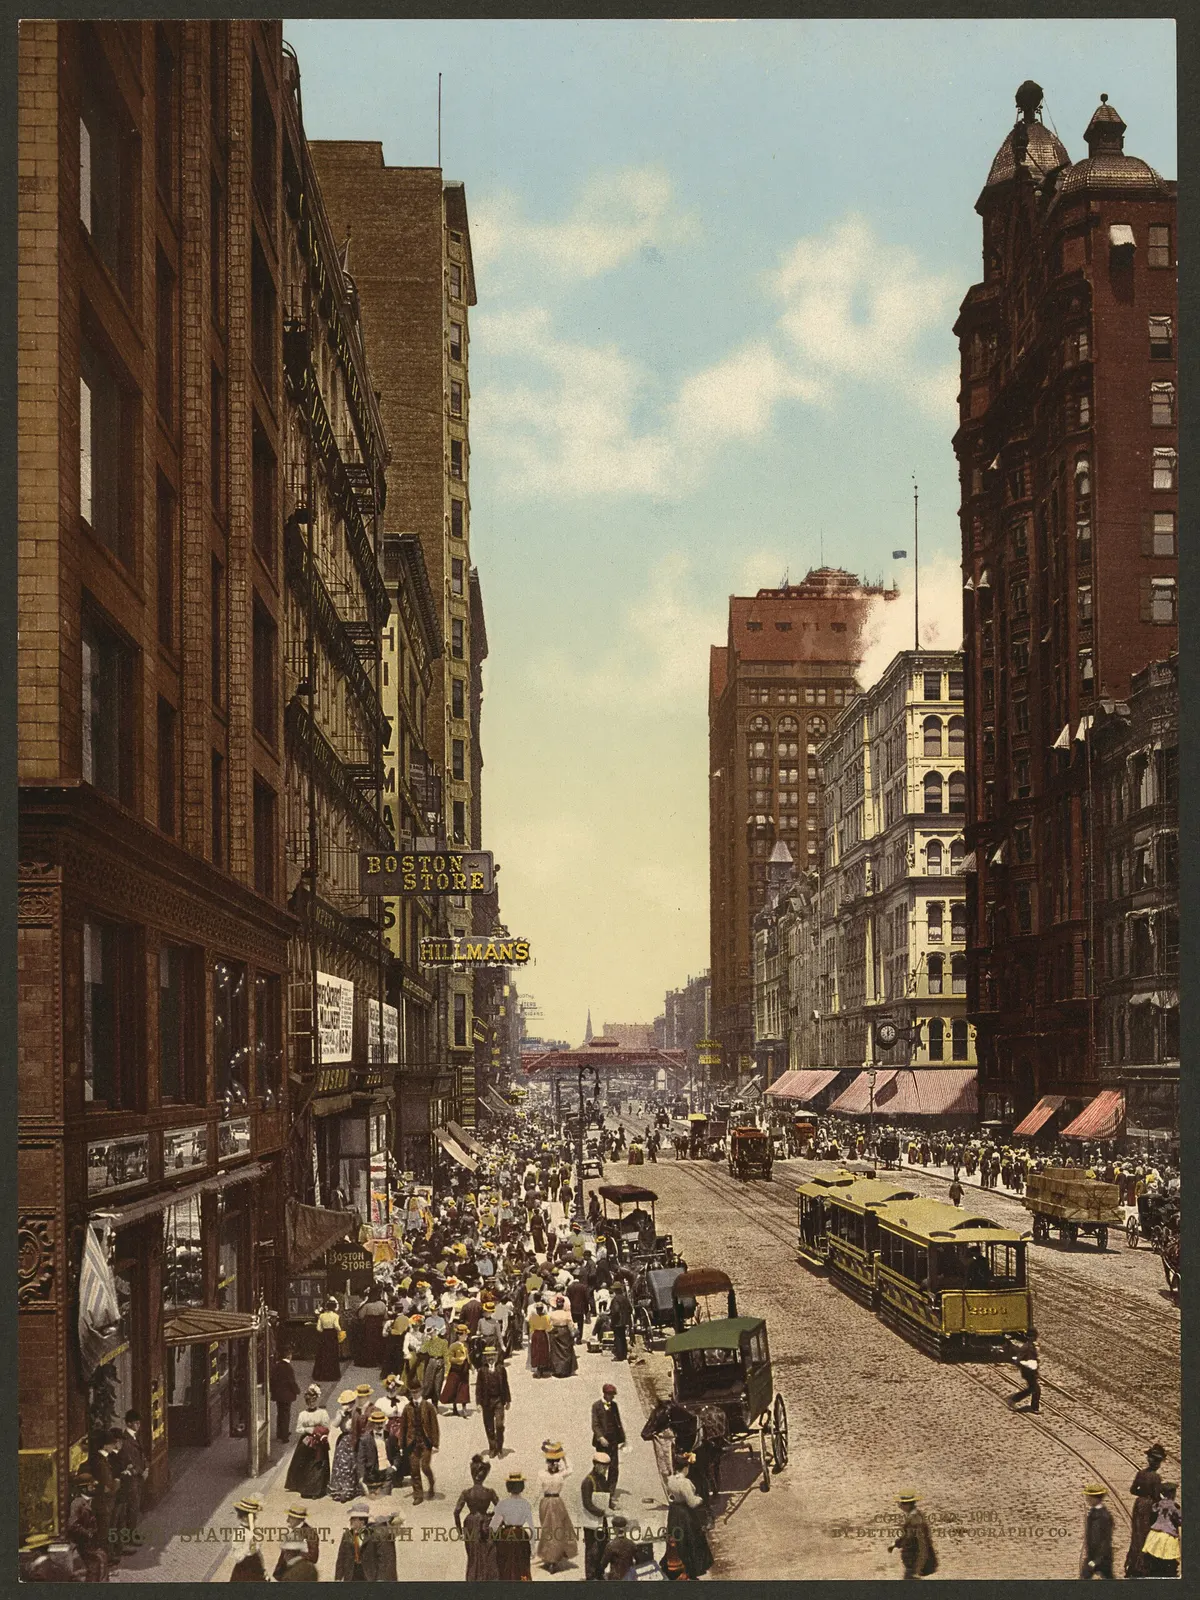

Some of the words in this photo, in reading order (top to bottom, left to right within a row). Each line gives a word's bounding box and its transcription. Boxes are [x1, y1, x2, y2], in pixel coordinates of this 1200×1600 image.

[367, 855, 463, 874] BOSTON
[403, 872, 485, 891] STORE
[420, 941, 530, 961] HILLMAN'S
[329, 1250, 365, 1265] BOSTON
[341, 1261, 372, 1271] STORE
